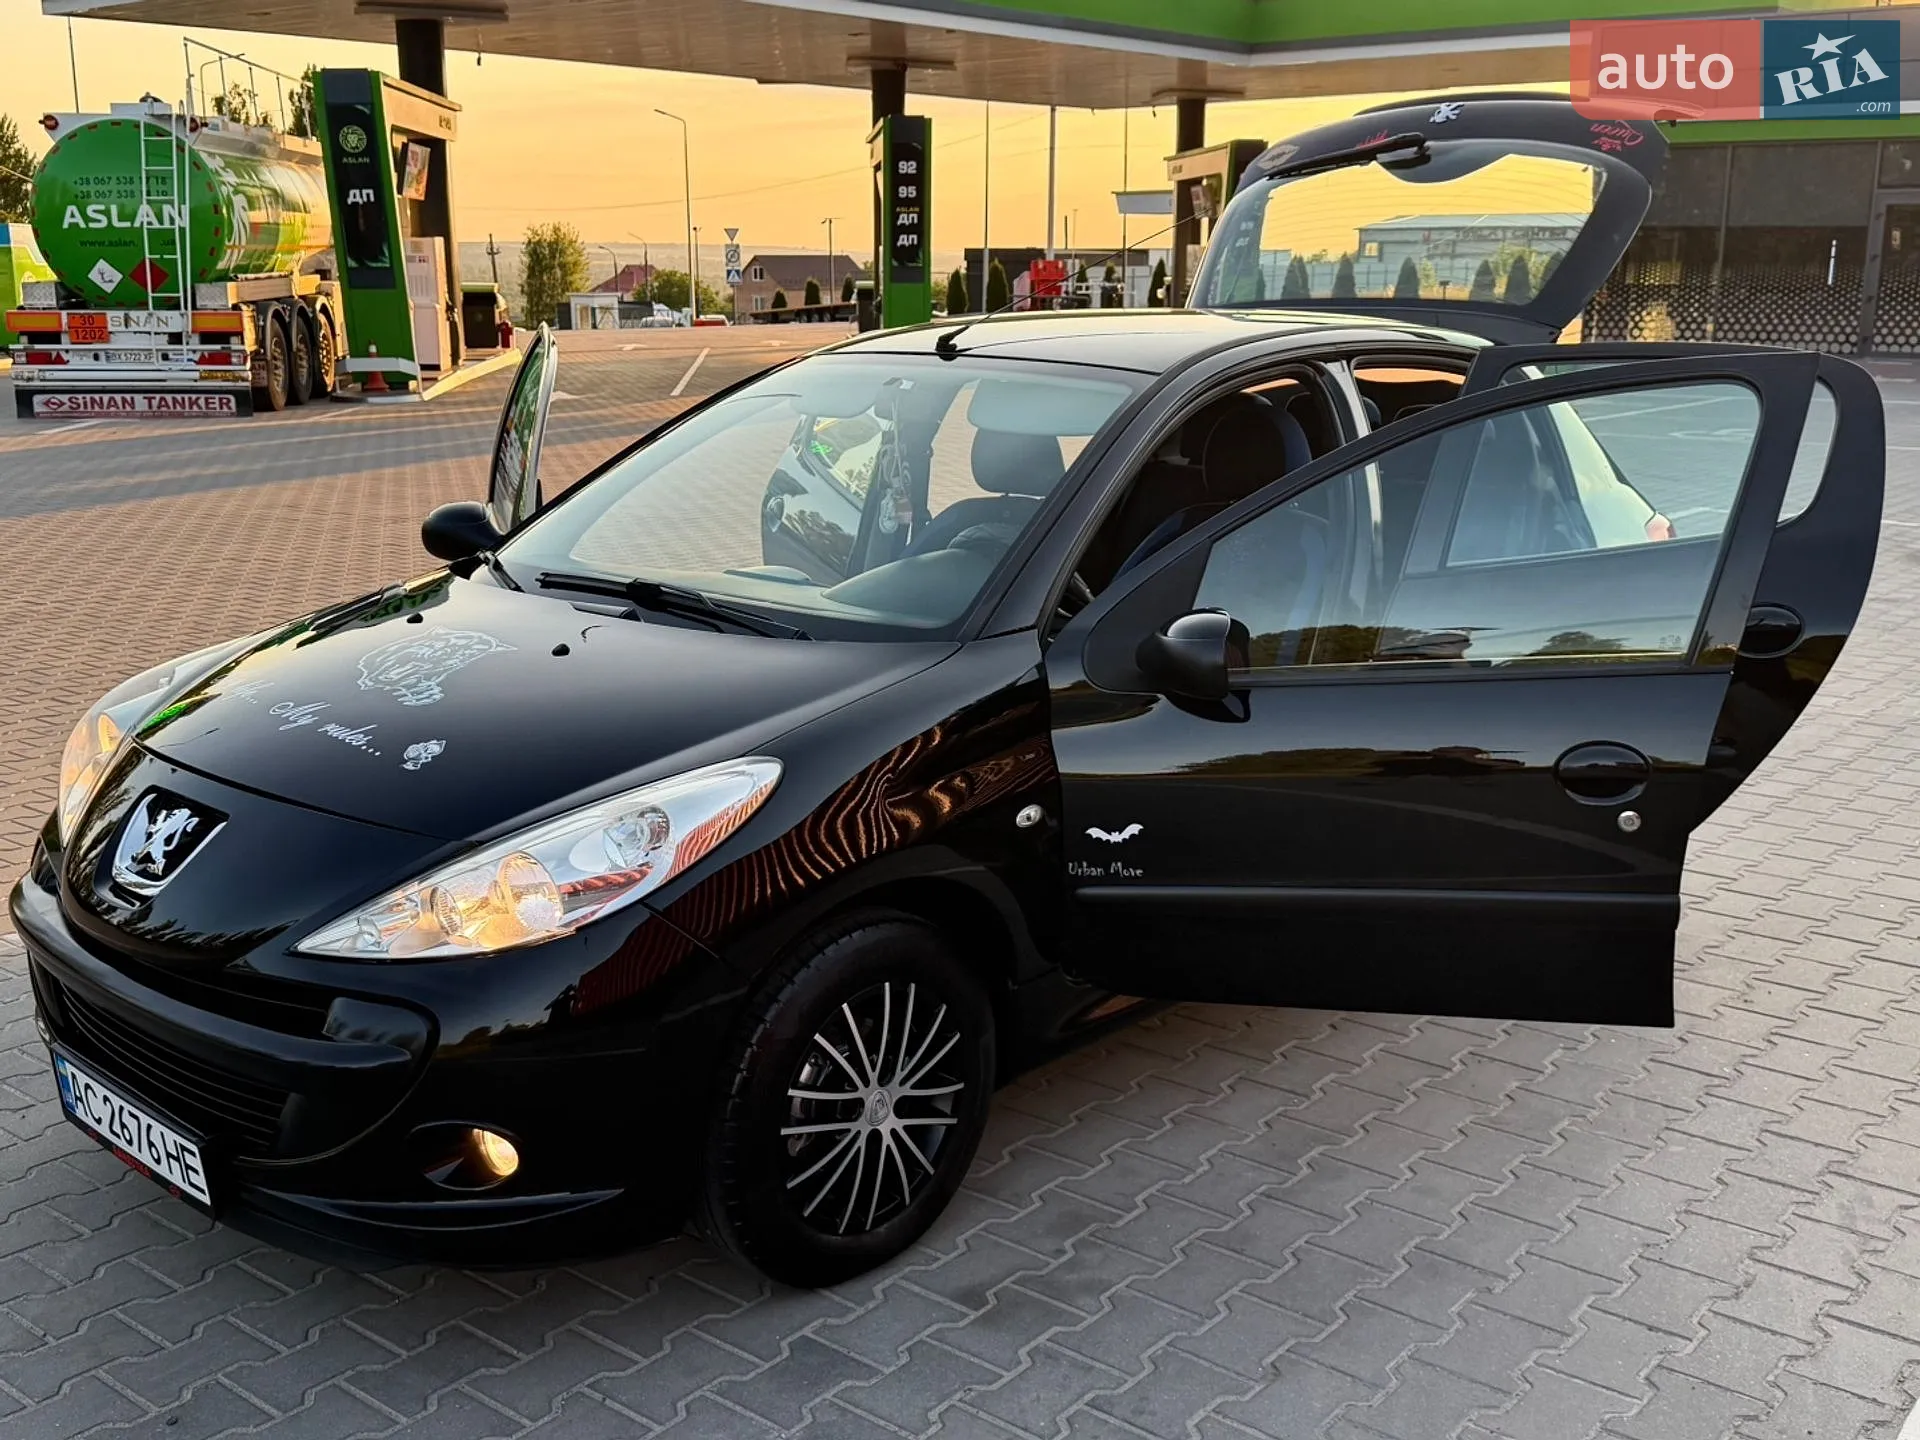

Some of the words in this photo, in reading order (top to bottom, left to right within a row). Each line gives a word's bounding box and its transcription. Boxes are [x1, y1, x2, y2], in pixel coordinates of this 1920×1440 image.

[898, 160, 917, 174] 92
[93, 176, 112, 185] 067
[94, 190, 112, 199] 067
[346, 188, 375, 205] ДП
[898, 185, 917, 198] 95
[62, 203, 189, 229] ASLAN
[896, 213, 918, 226] ДП
[896, 234, 918, 247] ДП
[79, 316, 95, 326] 30
[74, 329, 105, 341] 1202
[143, 396, 233, 411] TANKER
[1067, 861, 1105, 877] Urban
[71, 1071, 103, 1126] AC
[103, 1094, 162, 1166] 2676
[160, 1130, 207, 1196] HE
